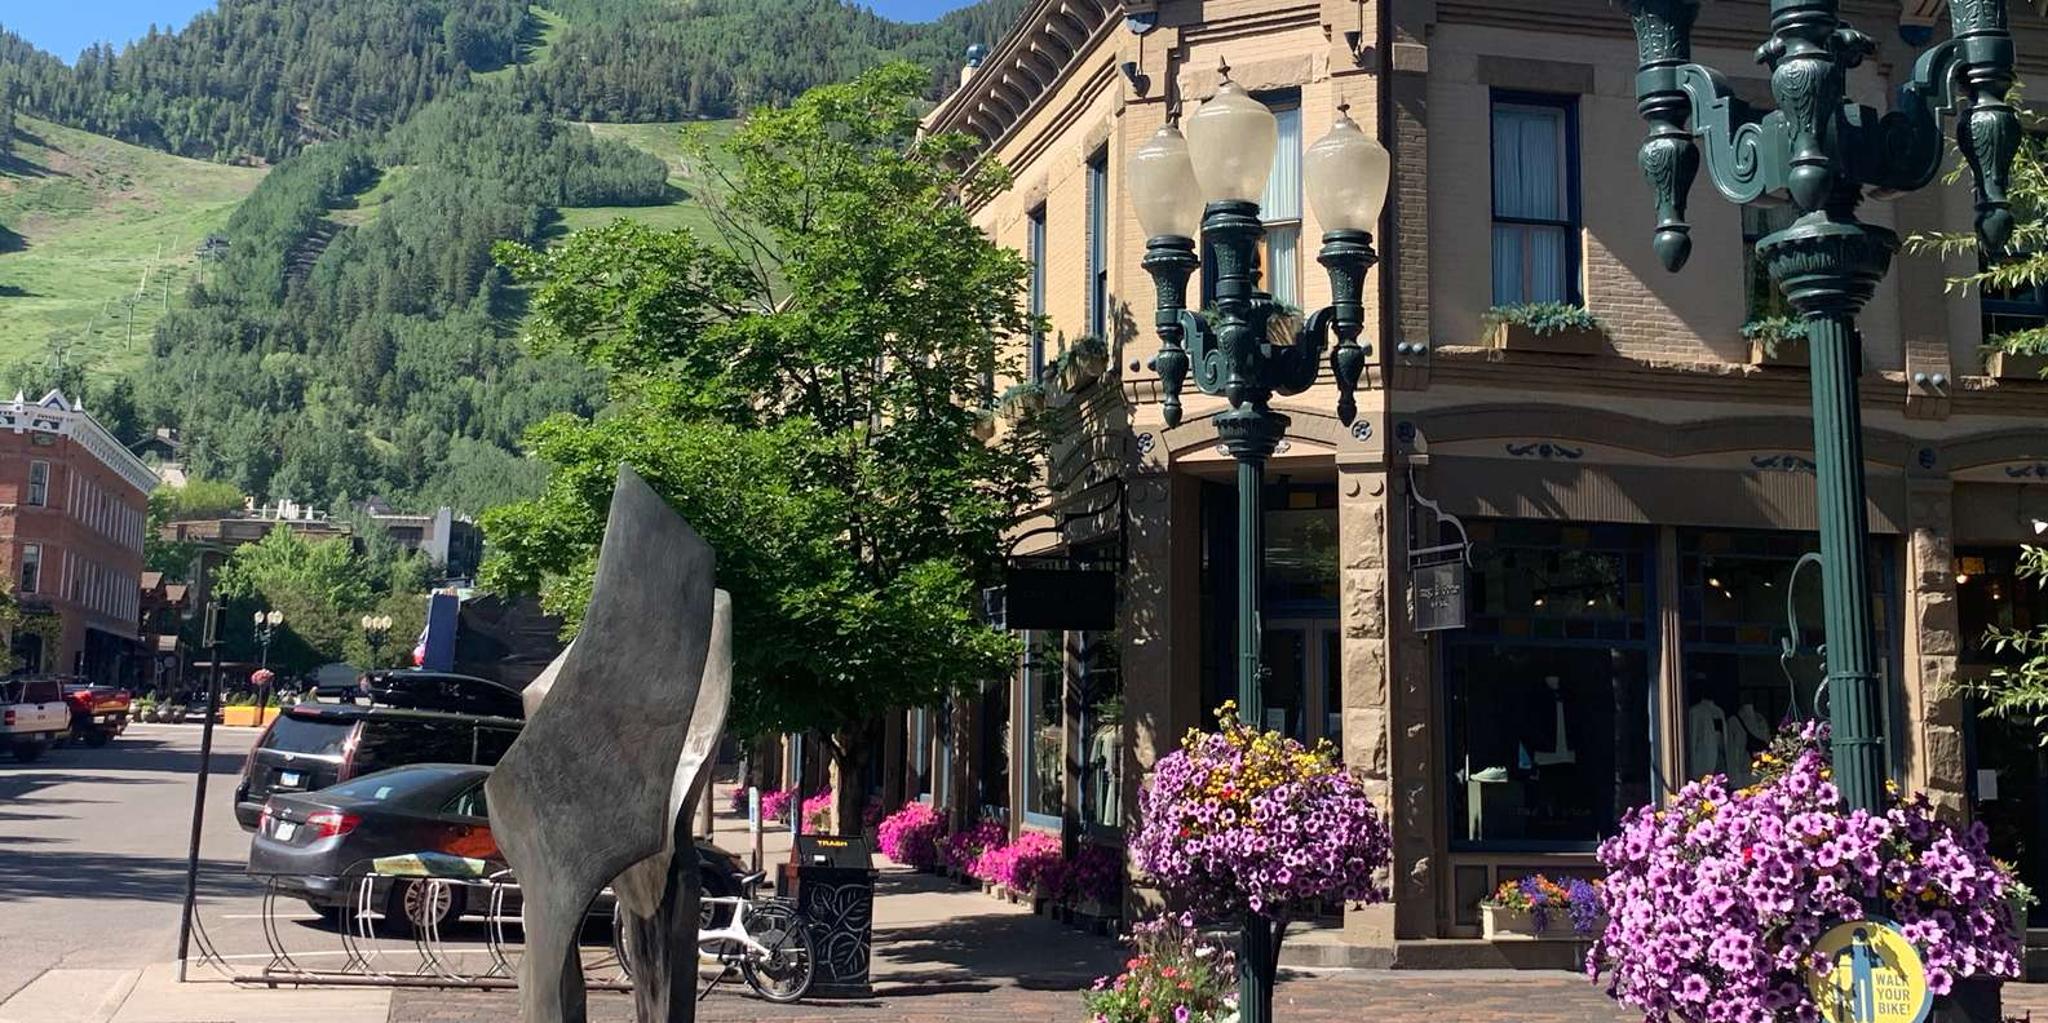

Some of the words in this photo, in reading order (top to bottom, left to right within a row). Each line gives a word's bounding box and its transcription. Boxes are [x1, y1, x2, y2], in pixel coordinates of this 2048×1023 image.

[1876, 974, 1909, 986] WALK
[1876, 988, 1910, 1001] YOUR
[1878, 1002, 1911, 1015] BIKE!
